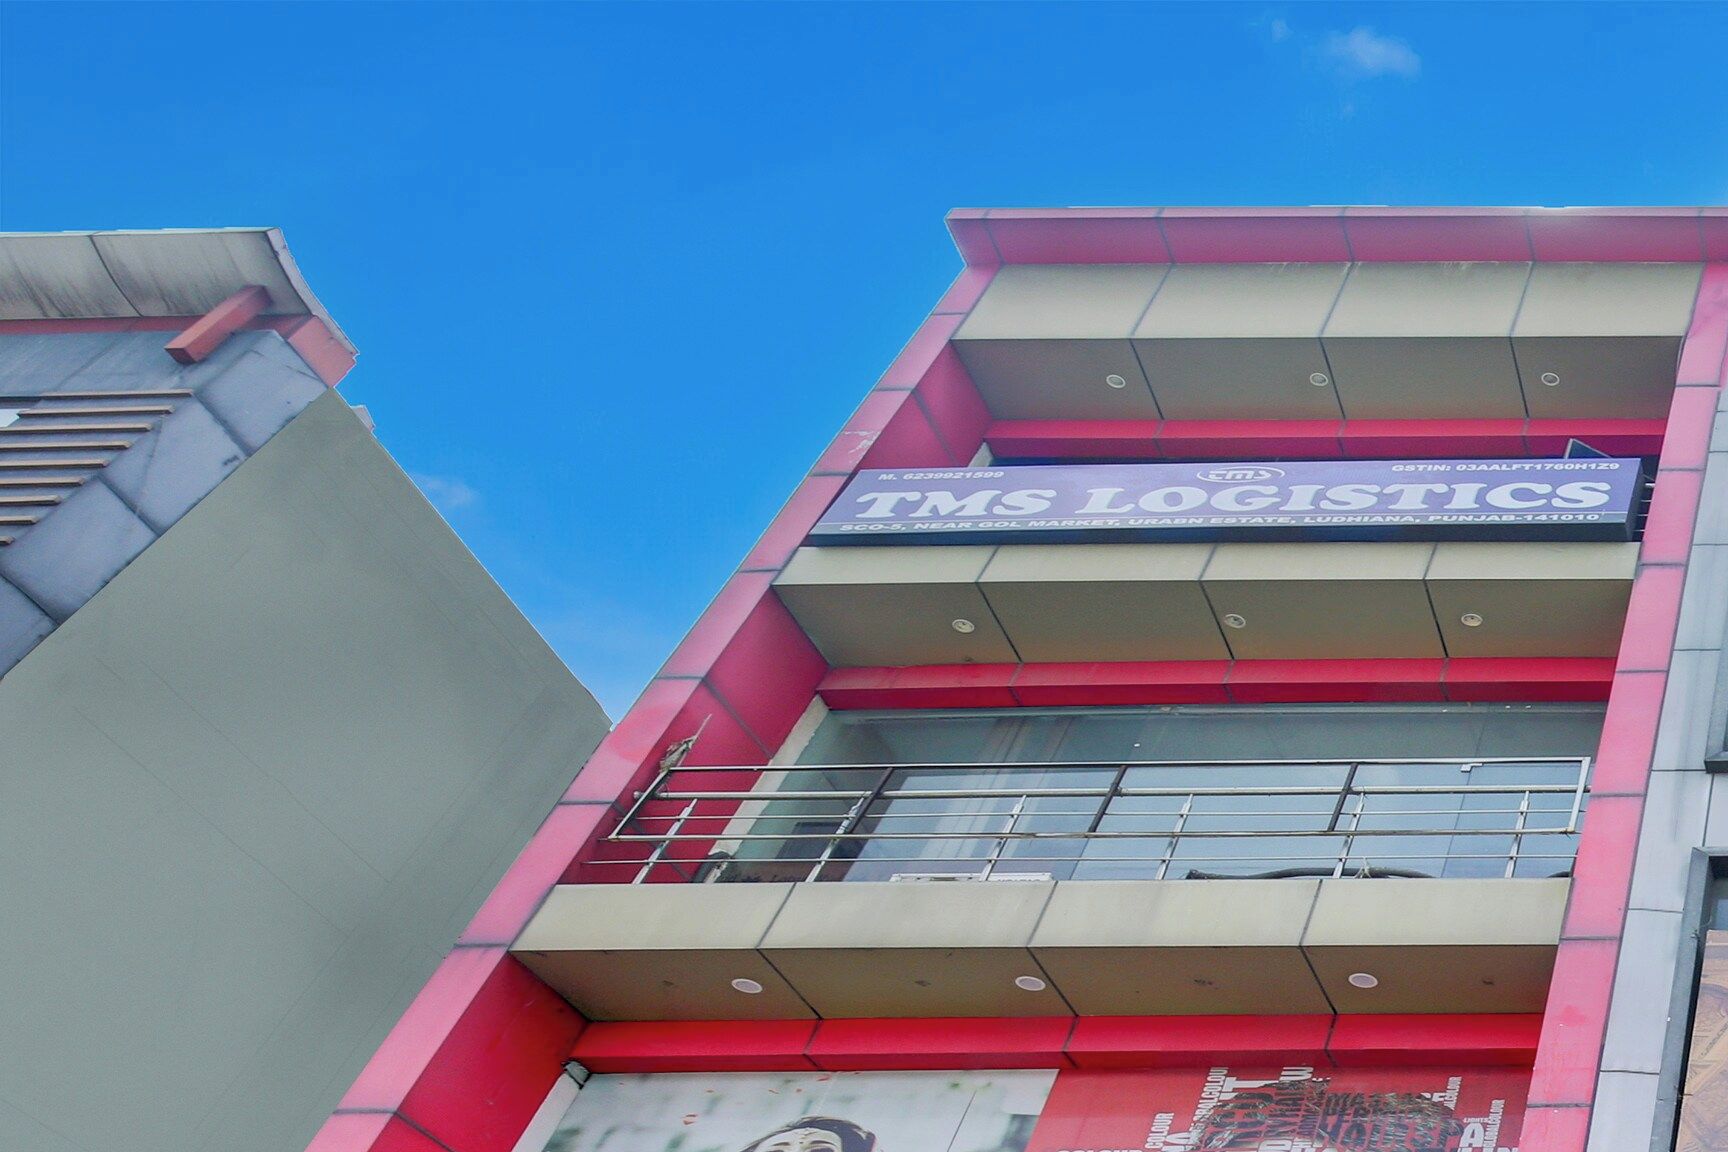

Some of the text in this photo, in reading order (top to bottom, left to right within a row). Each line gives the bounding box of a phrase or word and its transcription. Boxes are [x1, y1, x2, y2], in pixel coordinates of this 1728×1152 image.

[855, 482, 1612, 519] TMS LOGISTICS
[912, 521, 973, 531] NEAR
[1026, 517, 1120, 530] MARKET,
[1209, 514, 1297, 526] ESTATE,
[1303, 513, 1422, 525] LUDHIANA,
